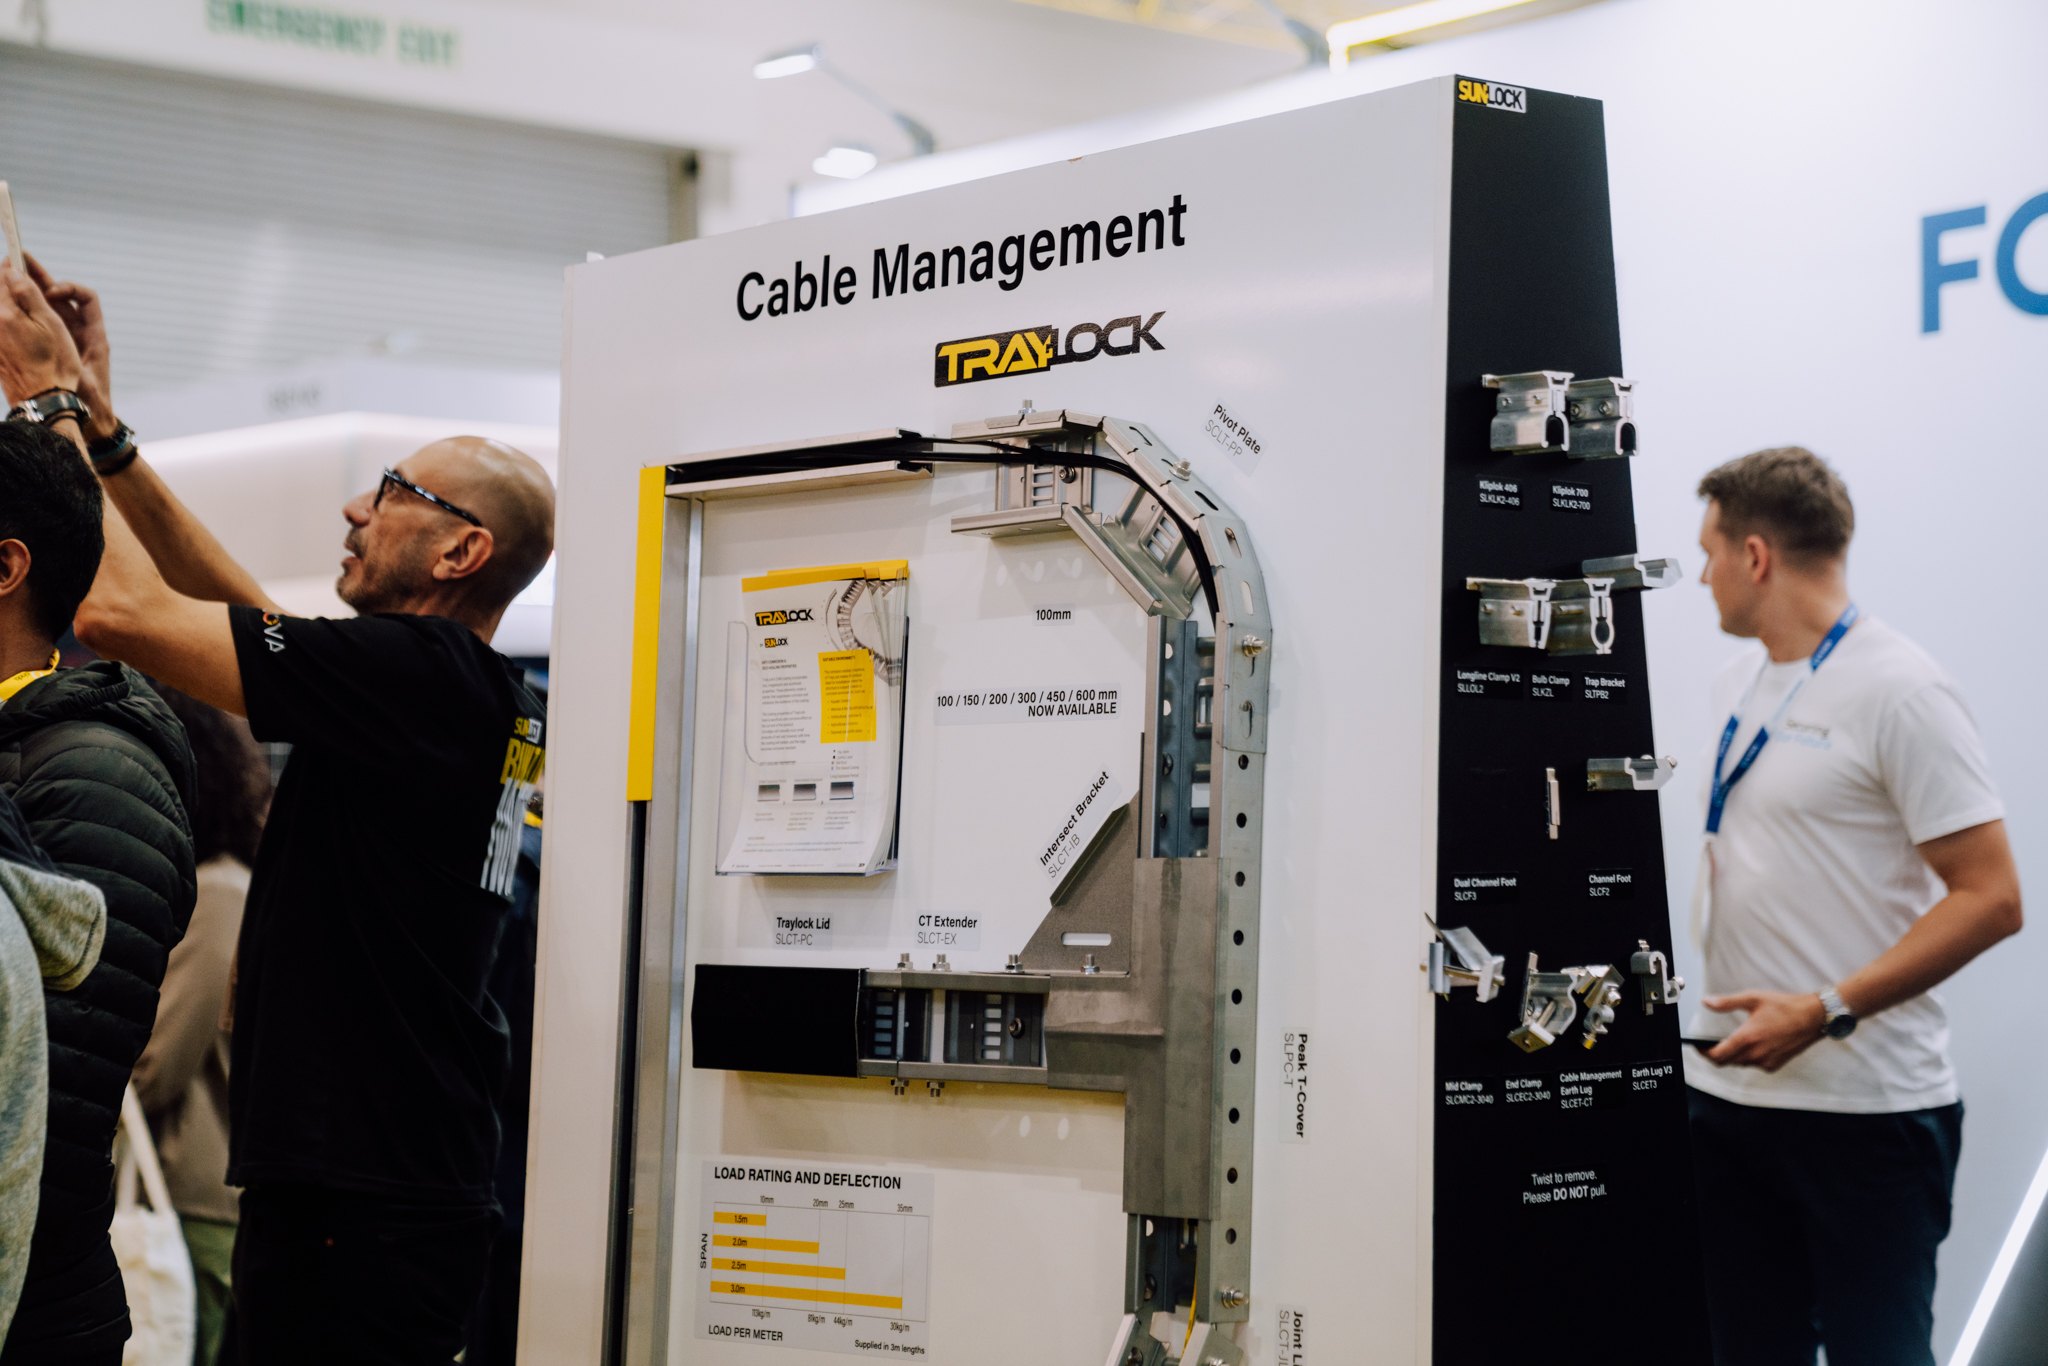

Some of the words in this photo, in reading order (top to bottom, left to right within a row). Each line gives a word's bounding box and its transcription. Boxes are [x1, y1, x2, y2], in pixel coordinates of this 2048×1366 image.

[1458, 80, 1523, 110] SUNLOCK
[736, 255, 857, 322] Cable
[872, 194, 1189, 299] Management
[936, 311, 1166, 384] TRAYLOCK
[1213, 404, 1238, 432] Pivot
[1237, 426, 1261, 454] Plate
[1205, 419, 1243, 457] SCLT-PP
[1576, 488, 1589, 497] 700
[755, 609, 814, 626] TRAYLOCK
[1036, 609, 1072, 621] 100mm
[1488, 672, 1510, 683] Clamp
[1510, 673, 1521, 683] V2
[1532, 674, 1548, 684] Bulb
[1548, 675, 1570, 687] Clamp
[1584, 677, 1600, 688] Trap
[1600, 677, 1626, 688] Bracket
[937, 695, 954, 707] 100
[964, 694, 980, 706] 150
[989, 693, 1008, 705] 200
[1018, 692, 1036, 703] 300
[1047, 690, 1066, 702] 450
[1076, 689, 1096, 701] 600
[1098, 689, 1118, 701] mm
[1028, 704, 1055, 717] NOW
[1057, 702, 1117, 716] AVAILABLE
[1040, 814, 1078, 866] Intersect
[1075, 771, 1109, 816] Bracket
[1048, 833, 1081, 878] SLCT-IB
[1454, 878, 1471, 888] Dual
[1471, 878, 1500, 888] Channel
[1500, 877, 1517, 887] Foot
[1589, 874, 1615, 884] Channel
[1616, 874, 1631, 883] Foot
[777, 917, 814, 931] Traylock
[816, 918, 830, 930] Lid
[919, 915, 932, 927] CT
[934, 915, 977, 928] Extender
[775, 933, 813, 946] SLCT-PC
[917, 932, 957, 945] SLCT-EX
[1297, 1033, 1308, 1072] Peak
[1283, 1033, 1294, 1088] SLPC-T
[1560, 1072, 1579, 1083] Cable
[1580, 1070, 1622, 1082] Management
[1632, 1068, 1649, 1078] Earth
[1650, 1067, 1663, 1077] Lug
[1663, 1065, 1673, 1075] V3
[1505, 1080, 1519, 1090] End
[1520, 1079, 1542, 1090] Clamp
[1560, 1085, 1578, 1096] Earth
[1579, 1085, 1592, 1096] Lug
[1296, 1075, 1307, 1138] T-Cover
[714, 1166, 746, 1181] LOAD
[748, 1168, 792, 1183] RATING
[794, 1171, 821, 1185] AND
[823, 1172, 901, 1189] DEFLECTION
[1531, 1173, 1553, 1186] Twist
[1554, 1173, 1563, 1183] to
[1564, 1170, 1598, 1182] remove.
[760, 1195, 774, 1204] 10mm
[1523, 1190, 1551, 1204] Please
[1553, 1187, 1567, 1201] DO
[1569, 1185, 1589, 1199] NOT
[1590, 1182, 1607, 1200] pull.
[813, 1198, 829, 1208] 20mm
[838, 1199, 854, 1209] 25mm
[897, 1203, 913, 1213] 35mm
[732, 1237, 748, 1247] 2.0m
[700, 1233, 708, 1269] SPAN
[731, 1261, 747, 1270] 2.5m
[730, 1284, 746, 1293] 3.0m
[708, 1325, 732, 1336] LOAD
[734, 1327, 751, 1338] PER
[752, 1329, 783, 1341] METER
[1293, 1310, 1303, 1350] Joint
[854, 1339, 882, 1351] Supplied
[883, 1341, 889, 1351] in
[890, 1343, 901, 1352] 3m
[901, 1344, 925, 1355] lengths
[1293, 1354, 1303, 1366] L
